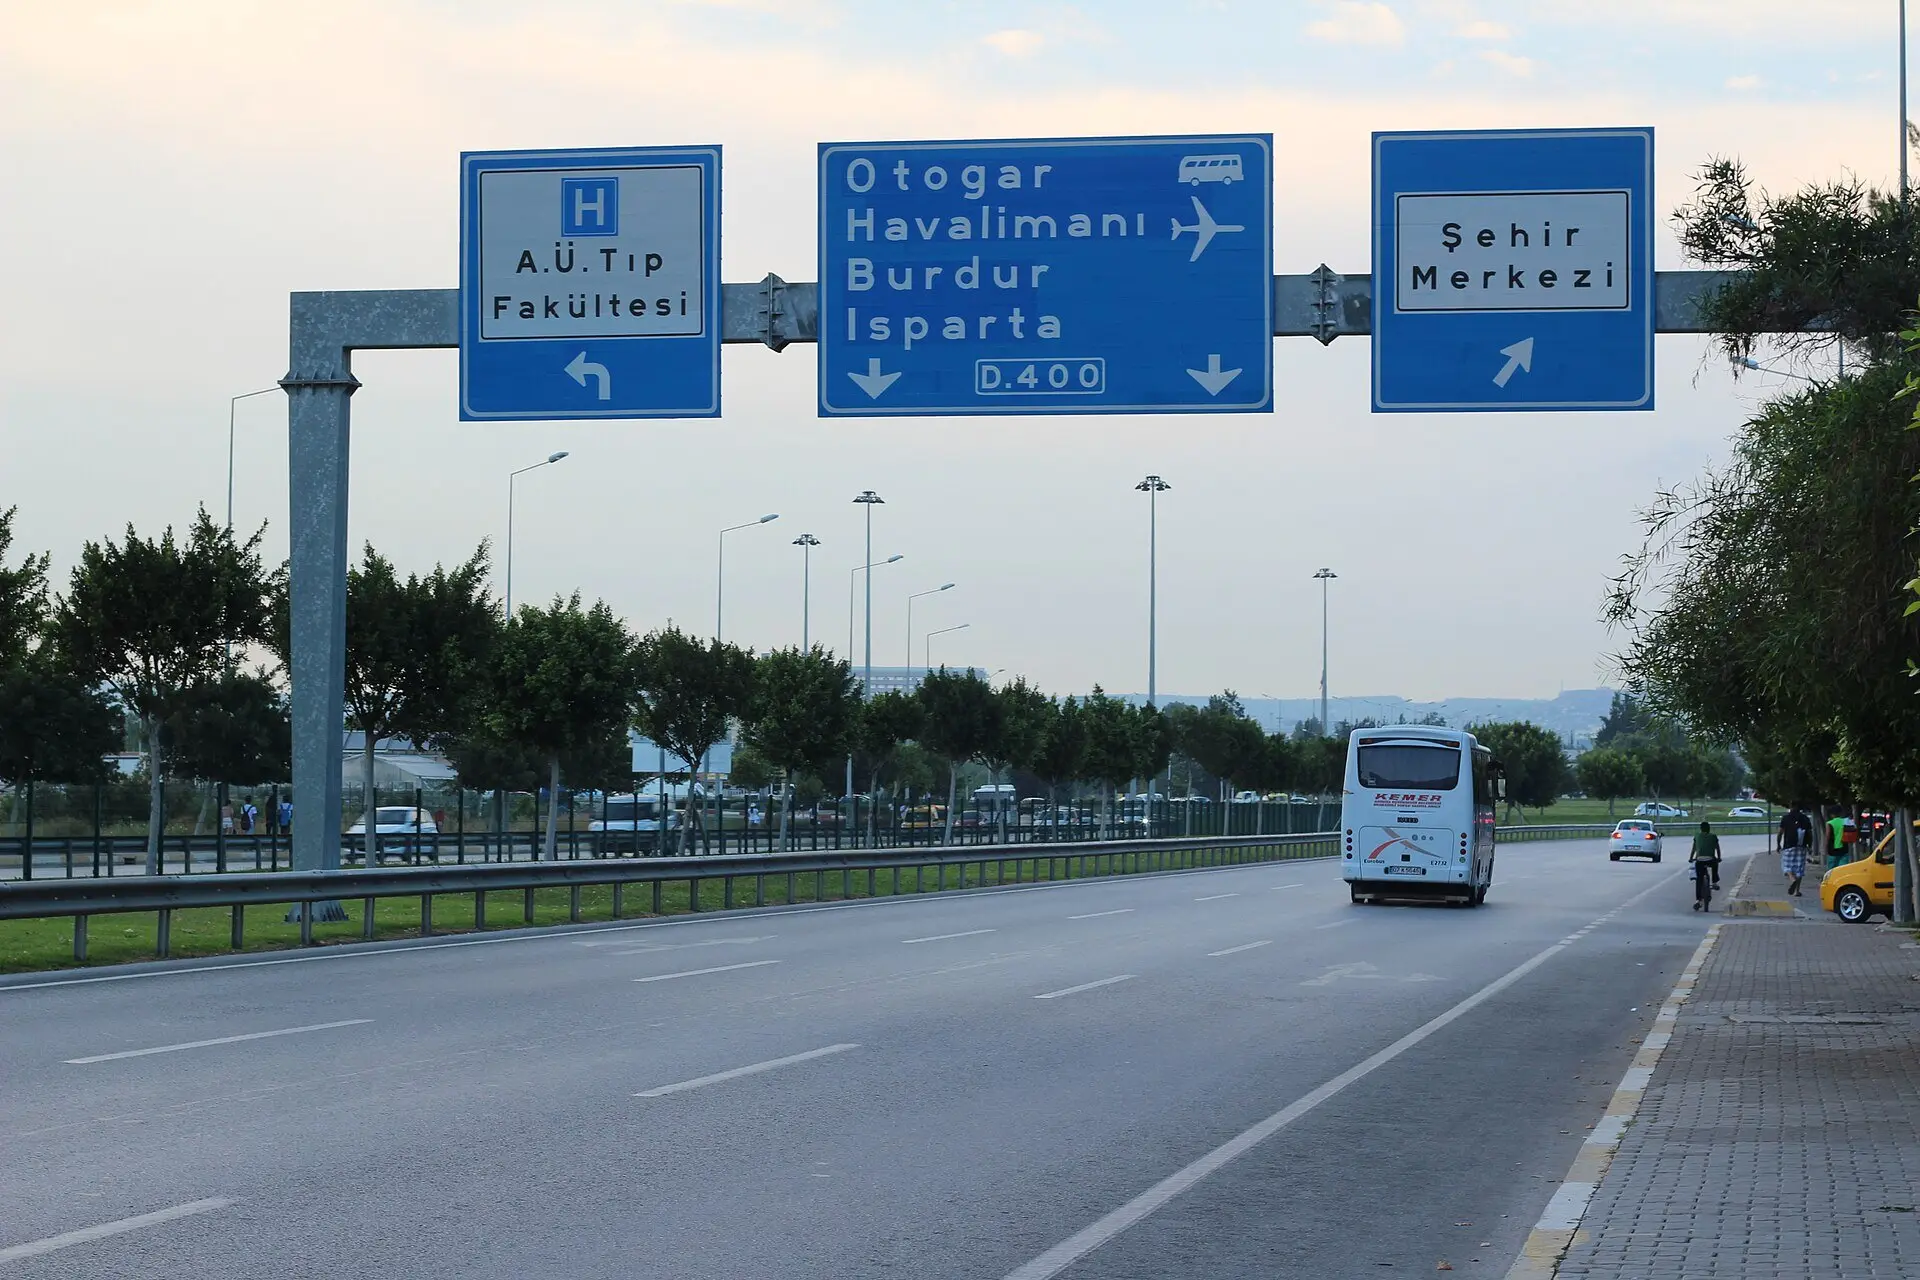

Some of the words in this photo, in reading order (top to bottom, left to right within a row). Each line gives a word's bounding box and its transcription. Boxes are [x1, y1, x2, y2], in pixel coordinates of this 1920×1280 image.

[847, 158, 1053, 200] Otogar
[575, 188, 605, 226] H
[847, 205, 1145, 242] Havalimanı
[1442, 221, 1580, 253] Şehir
[847, 255, 1050, 291] Burdur
[1412, 261, 1613, 290] Merkezi
[493, 290, 687, 320] Fakültesi
[848, 307, 1061, 351] Isparta
[981, 363, 1099, 390] D.400
[1375, 793, 1442, 801] KEMER
